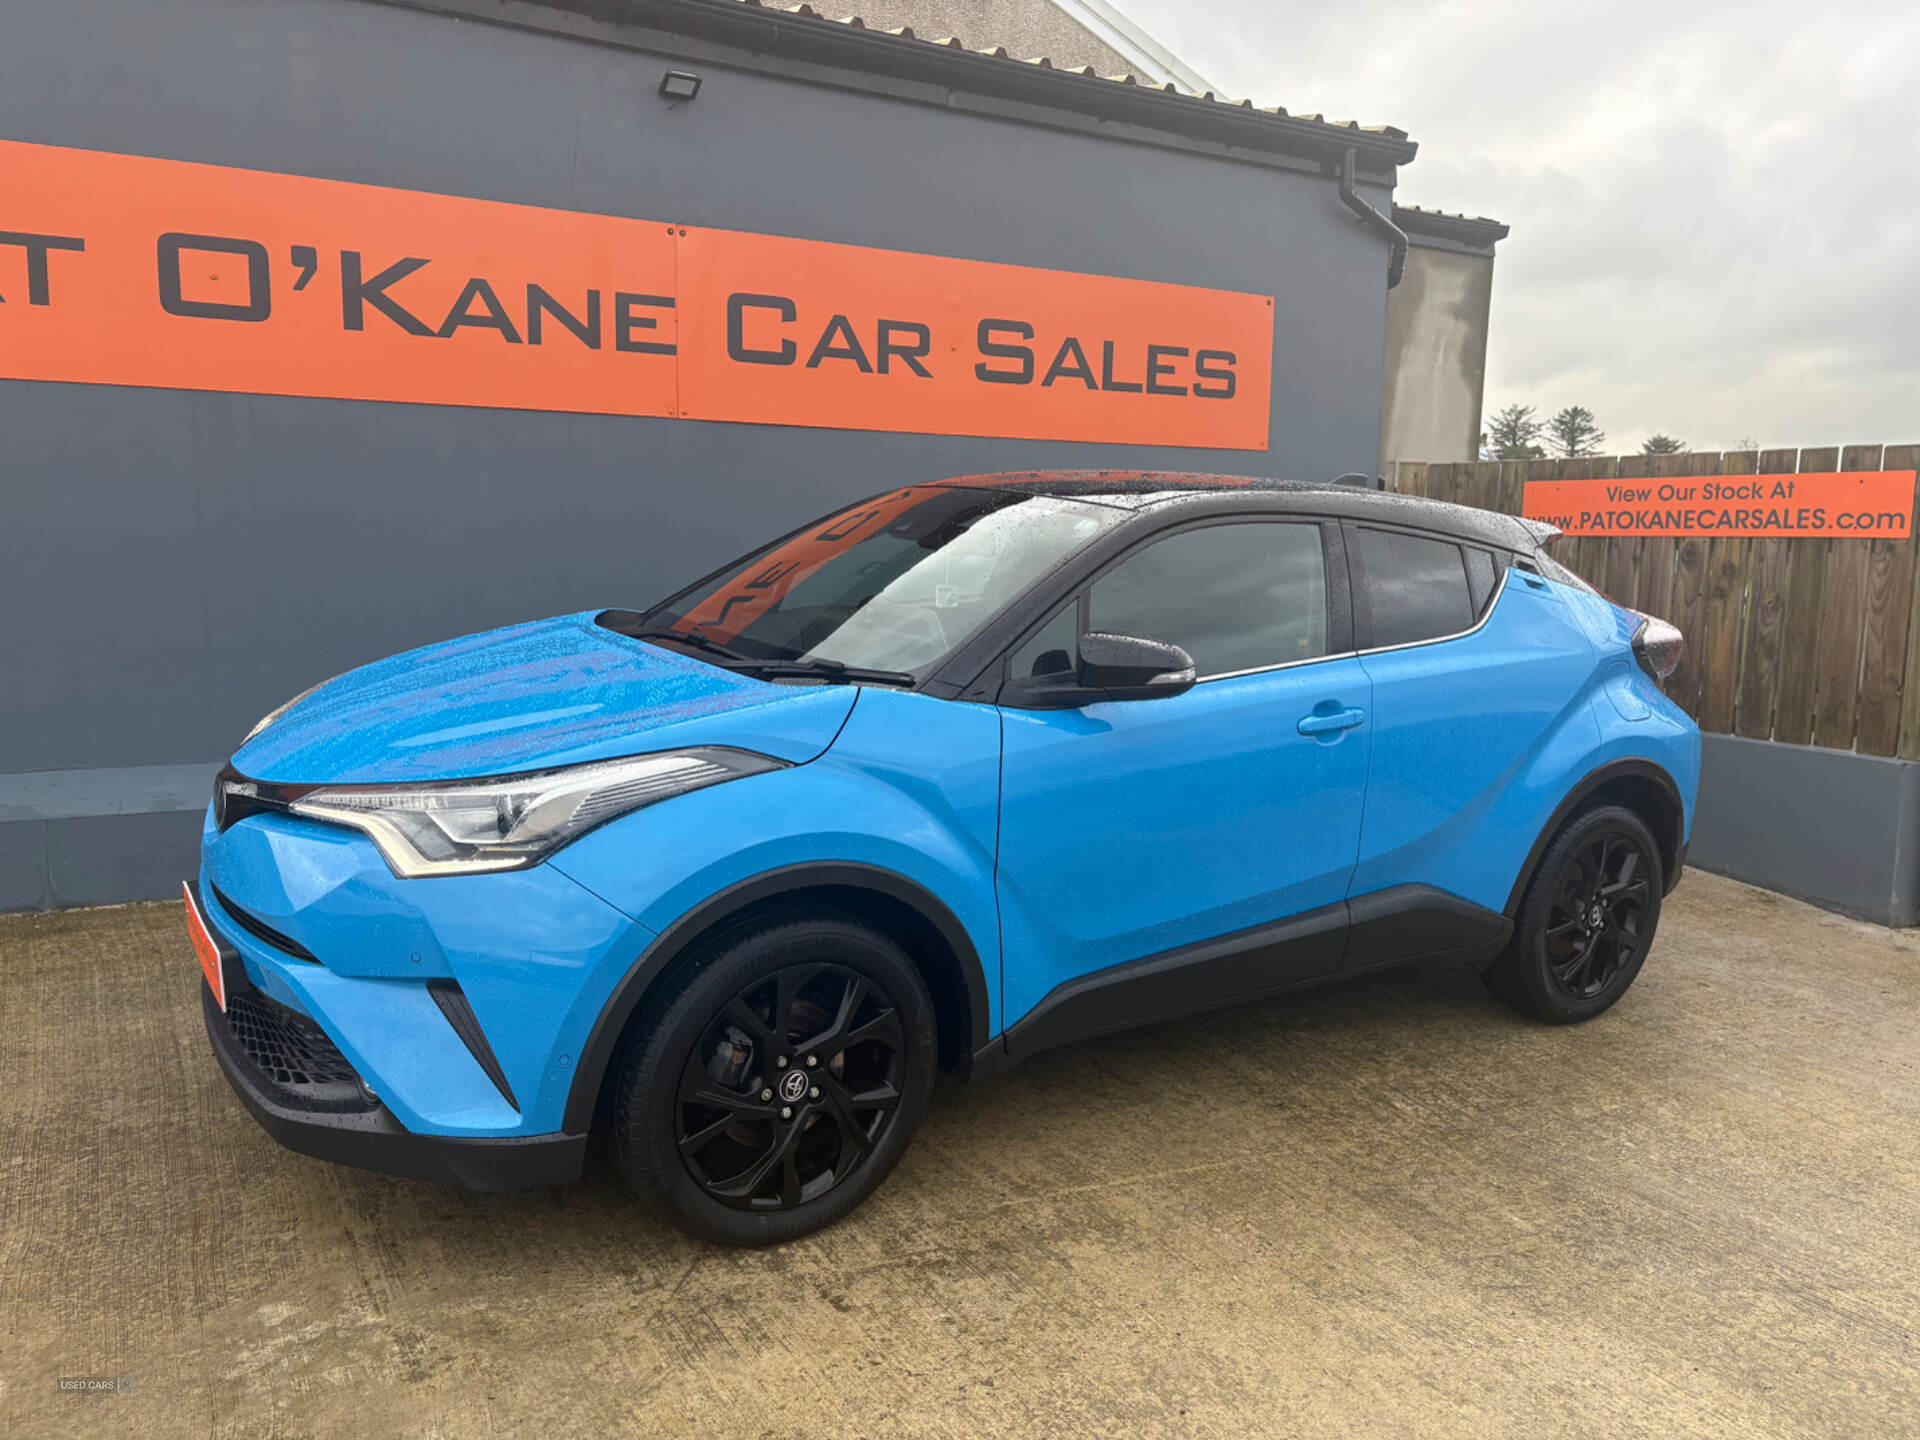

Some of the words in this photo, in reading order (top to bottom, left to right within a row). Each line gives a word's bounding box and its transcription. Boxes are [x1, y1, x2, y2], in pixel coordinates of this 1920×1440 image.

[0, 231, 85, 306] T
[157, 232, 678, 356] O'KANE
[726, 292, 934, 378] CAR
[974, 318, 1237, 399] SALES
[1606, 486, 1652, 502] View
[1658, 485, 1696, 502] Our
[1702, 482, 1763, 500] Stock
[1770, 481, 1796, 499] At
[1527, 508, 1906, 531] ww.PATOKANECARSALES.com
